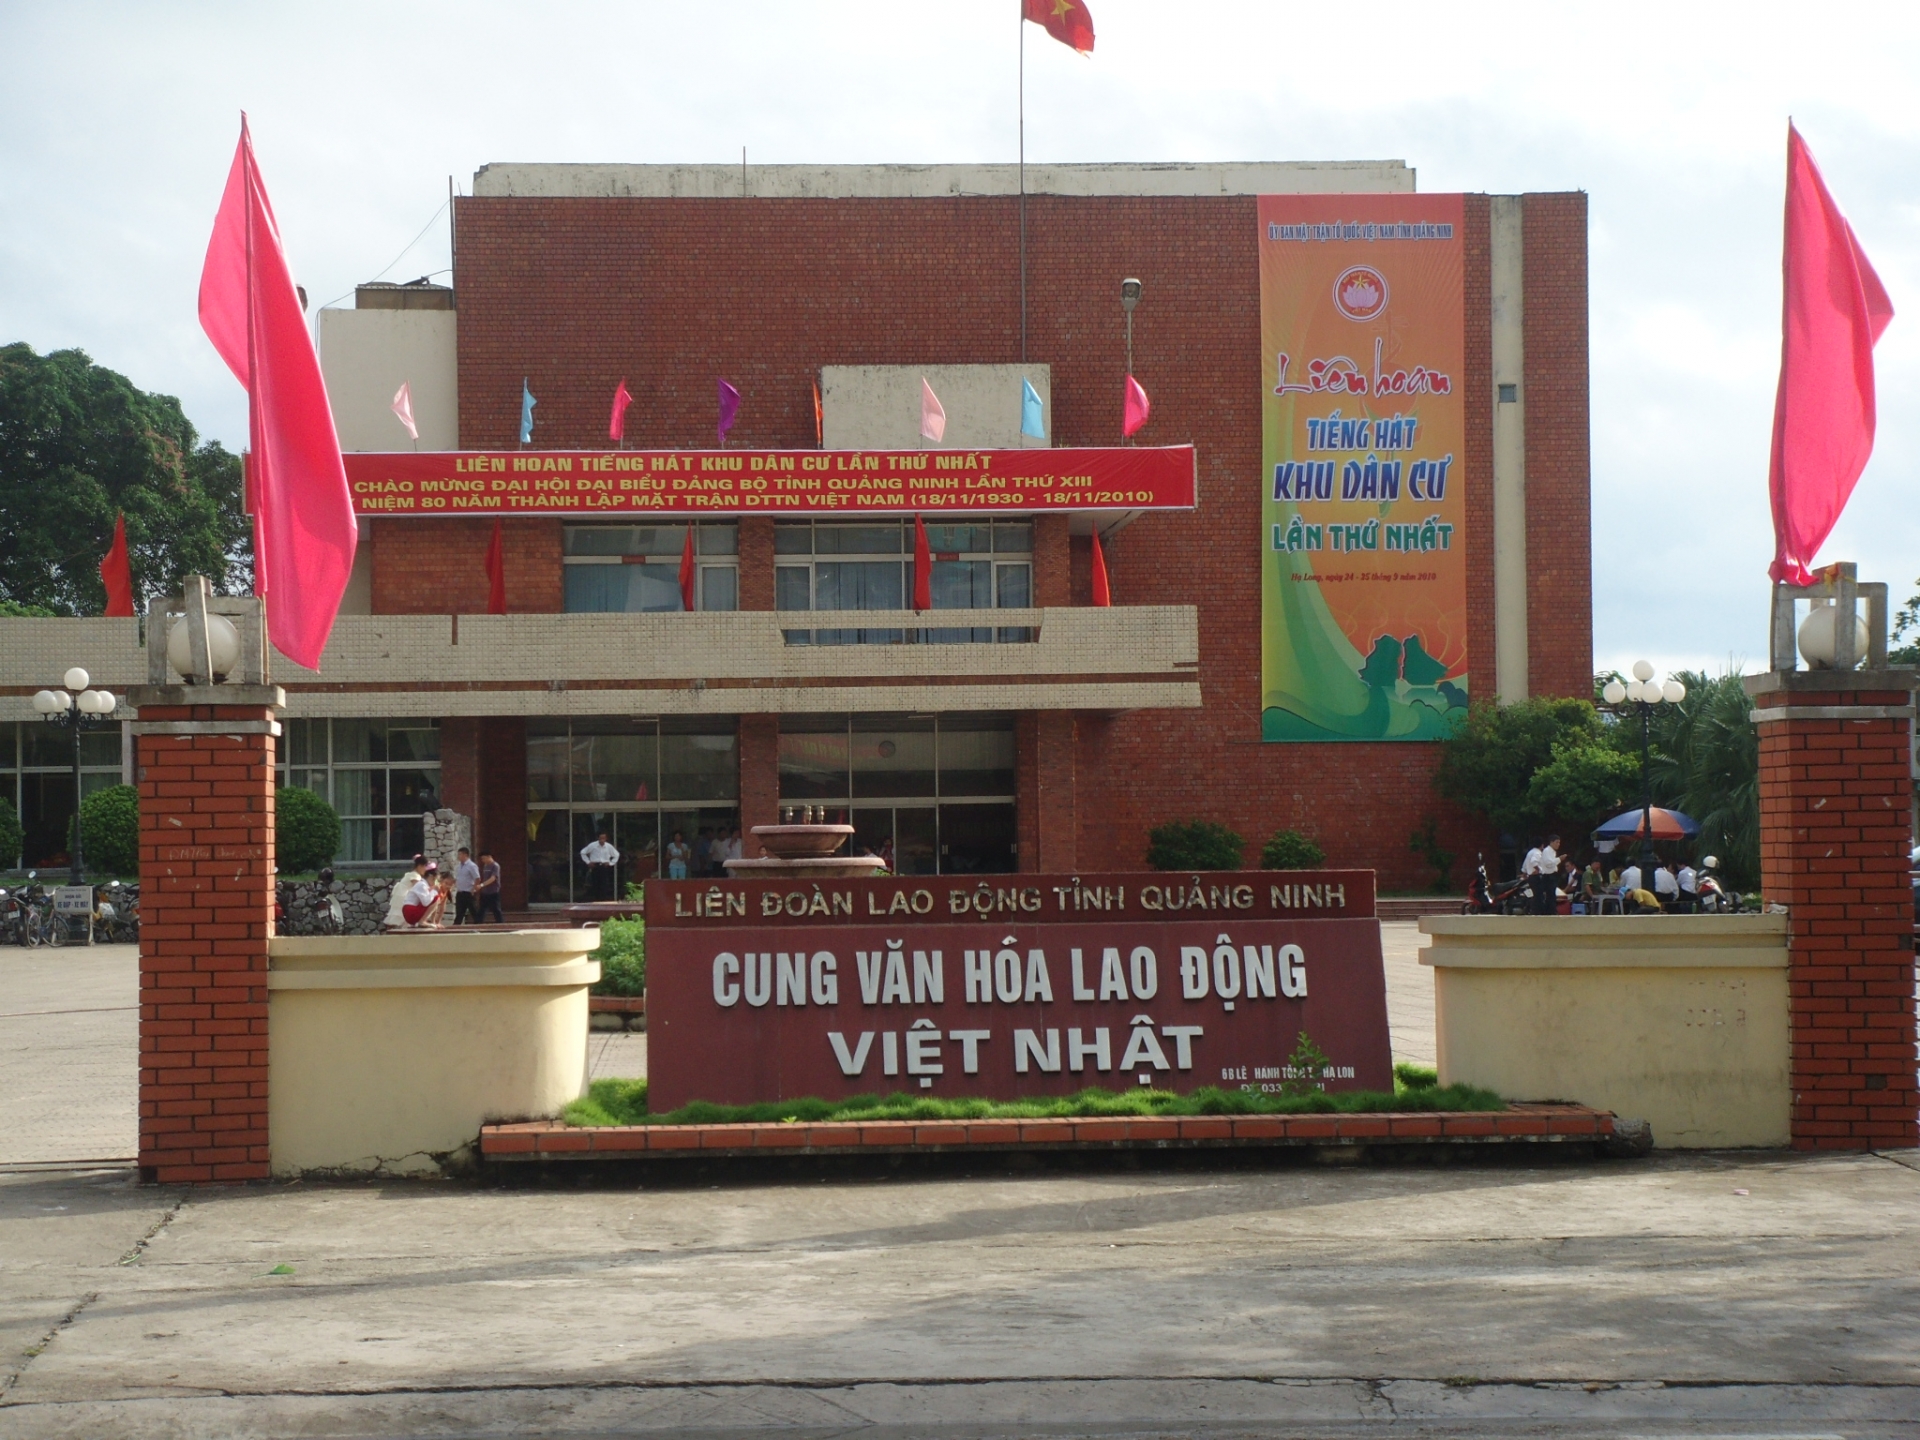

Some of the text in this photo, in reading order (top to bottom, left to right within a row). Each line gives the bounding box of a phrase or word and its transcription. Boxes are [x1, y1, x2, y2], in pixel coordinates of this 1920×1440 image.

[1379, 224, 1395, 239] NAM
[1435, 223, 1453, 239] NINH
[1307, 408, 1417, 451] TIẾNG HÁT
[456, 453, 992, 473] LIÊN HOAN TIẾNG HÁT KHU DÂN CƯ LẦN THỨ NHẤT
[1273, 453, 1452, 502] KHU DÂN CƯ
[354, 473, 1093, 494] CHÀO MỪNG ĐẠI HỘI ĐẠI BIỂU ĐẢNG BỘ TỈNH QUẢNG NINH LẦN THỨ XIII
[362, 495, 415, 511] NIỆM
[421, 497, 446, 508] 80
[452, 494, 501, 508] NĂM
[507, 493, 579, 507] THÀNH
[585, 492, 626, 509] LẬP
[631, 492, 678, 508] MẶT
[683, 493, 739, 509] TRẬN
[745, 494, 801, 507] DTTN
[806, 491, 851, 508] VIỆT
[856, 493, 905, 506] NAM
[911, 492, 1024, 506] (18/11/1930
[1042, 491, 1155, 505] 18/11/2010)
[1272, 514, 1454, 554] LẦN THỨ NHẤT
[675, 875, 1346, 920] LIÊN ĐOÀN LAO ĐỘNG TỈNH QUẢNG NINH
[712, 952, 838, 1008] CUNG
[856, 939, 945, 1005] VĂN
[1070, 946, 1158, 1001] LAO
[1180, 933, 1308, 1011] ĐỘNG
[827, 1014, 1204, 1088] VIỆT NHẬT
[1236, 1065, 1247, 1080] LÊ
[1323, 1066, 1336, 1081] HẠ
